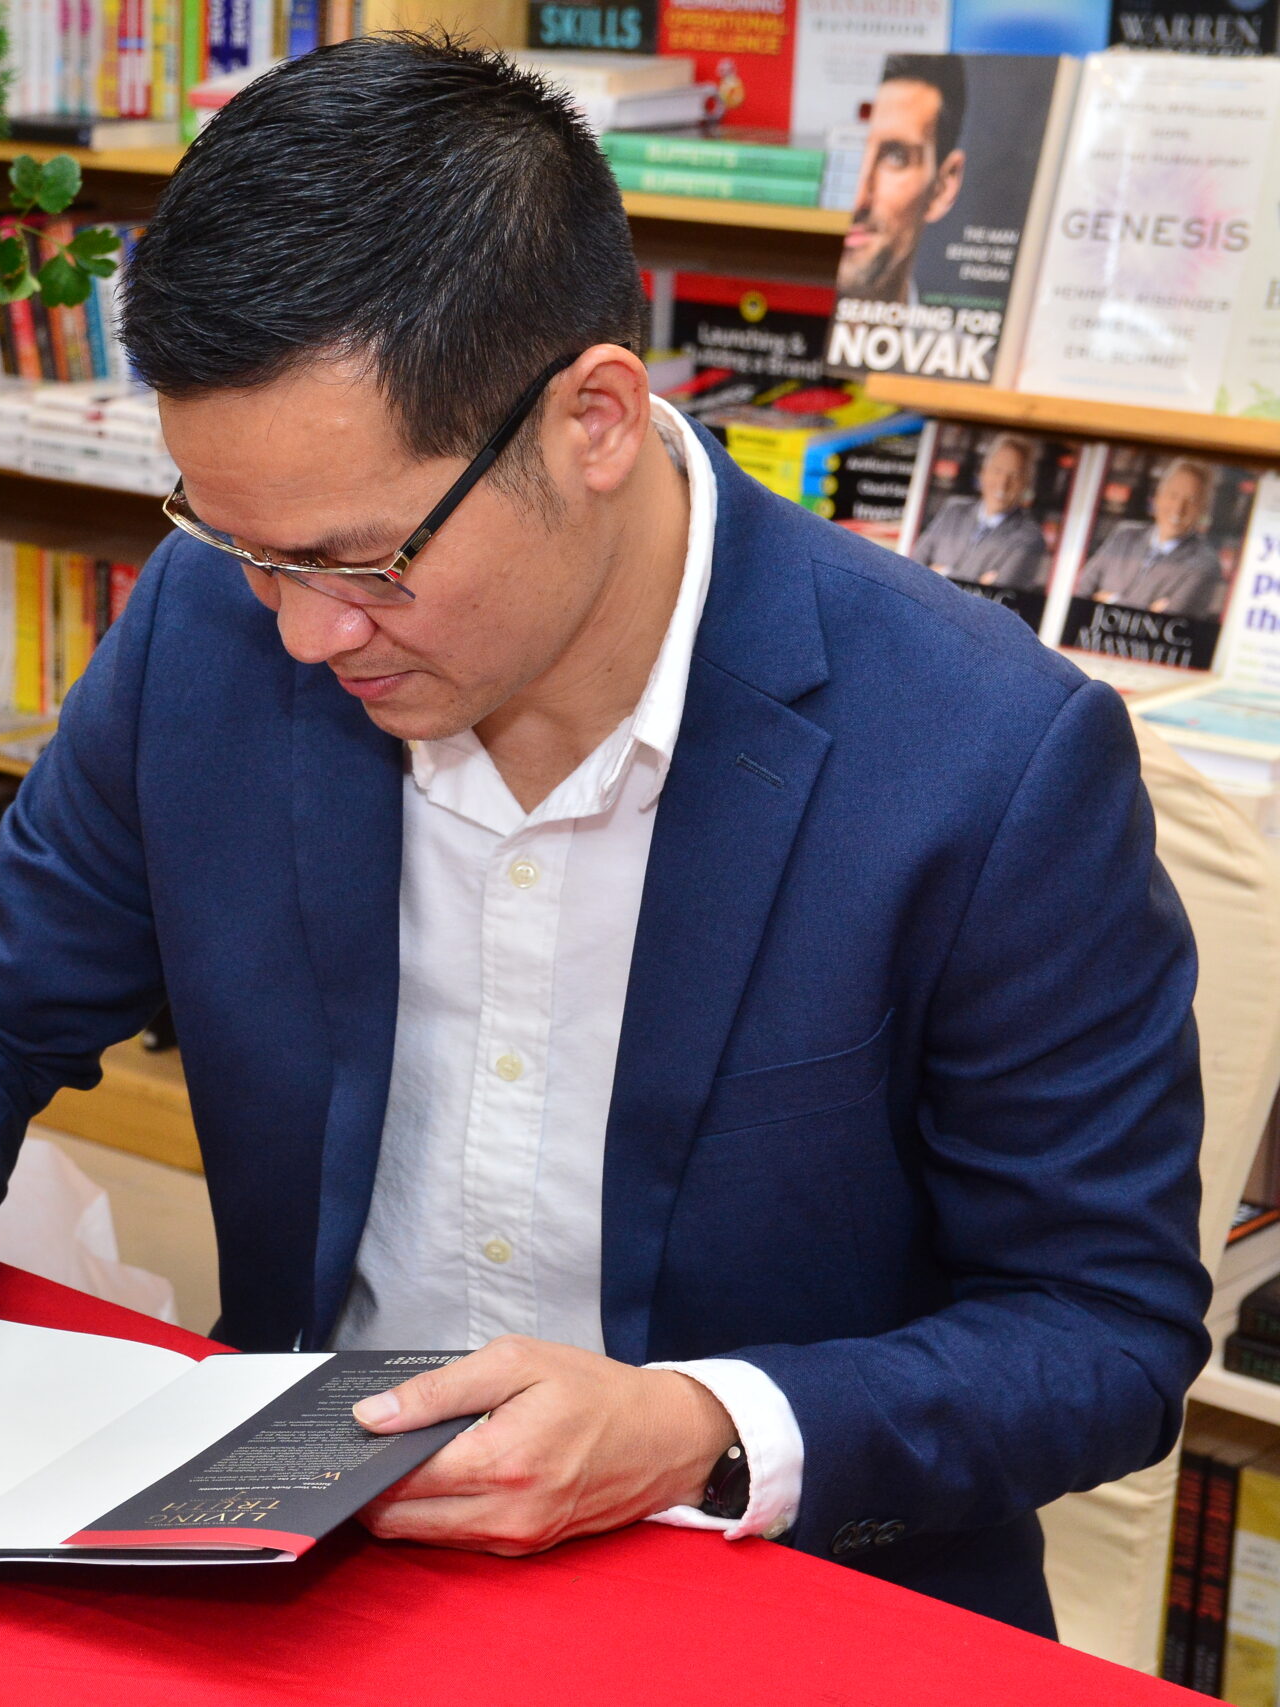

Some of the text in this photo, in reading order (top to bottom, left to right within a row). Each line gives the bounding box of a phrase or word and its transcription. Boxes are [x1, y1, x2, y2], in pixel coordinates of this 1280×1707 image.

[540, 4, 642, 49] SKILLS
[1121, 12, 1263, 45] WARREN
[963, 225, 1019, 244] THE MAN
[1060, 209, 1251, 252] GENESIS
[836, 298, 954, 331] SEARCHING
[955, 309, 1002, 336] FOR
[696, 322, 786, 356] Launching
[827, 322, 998, 380] NOVAK
[1091, 604, 1193, 648] JOHN C.
[144, 1512, 267, 1524] LIVING
[161, 1500, 281, 1512] TRUTH
